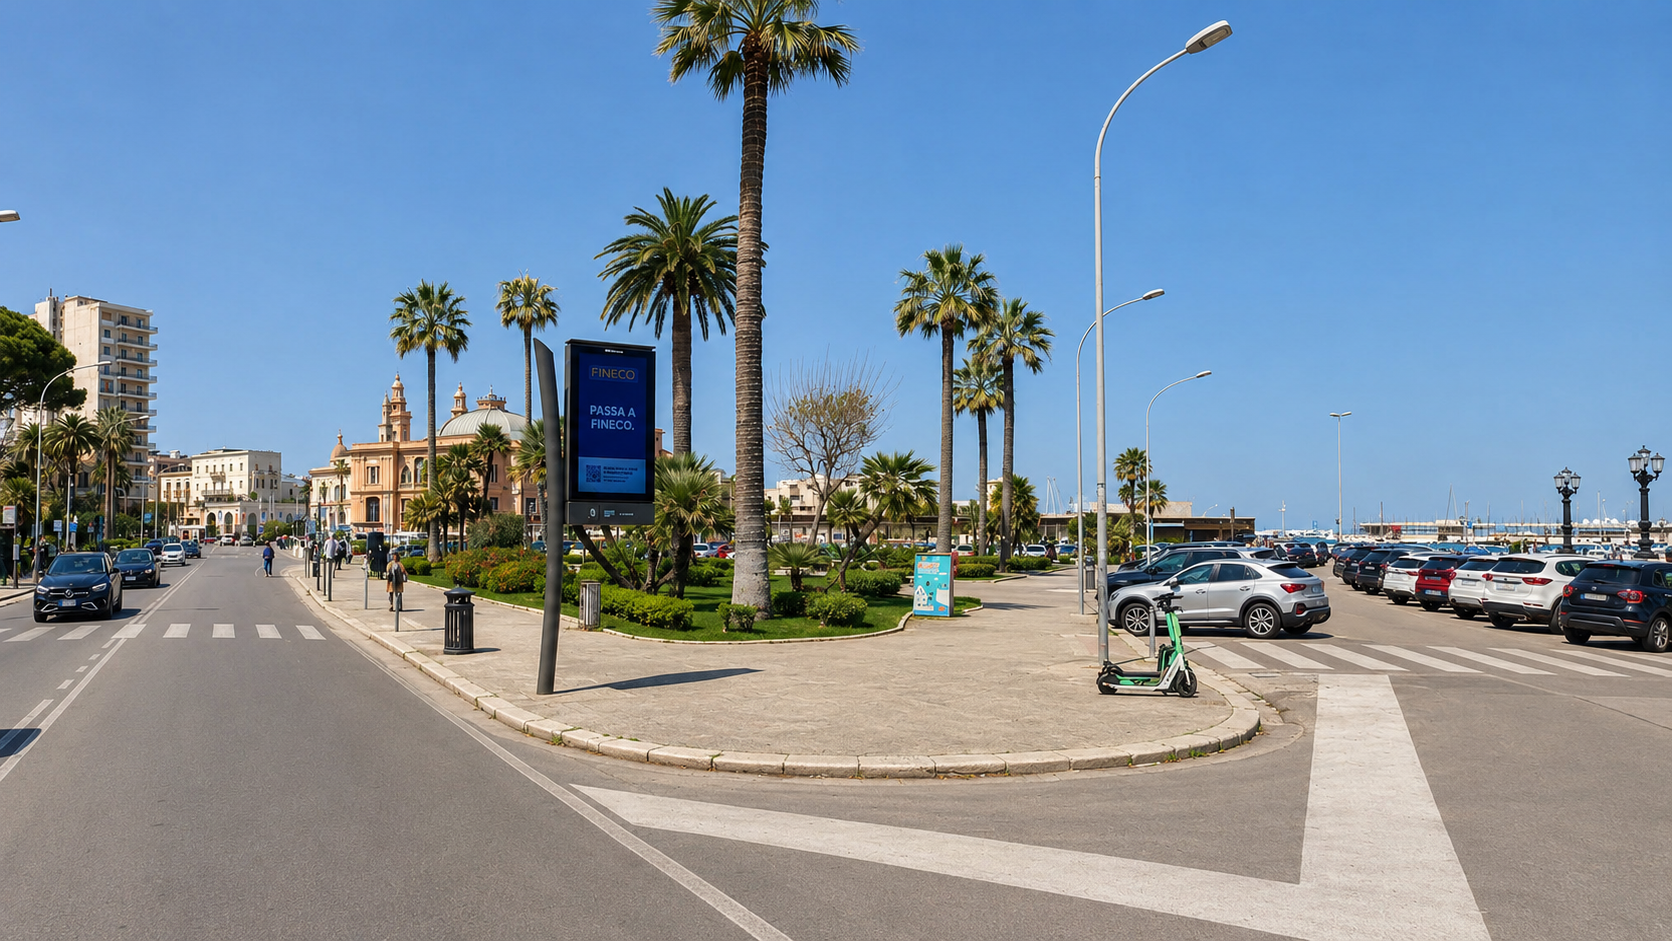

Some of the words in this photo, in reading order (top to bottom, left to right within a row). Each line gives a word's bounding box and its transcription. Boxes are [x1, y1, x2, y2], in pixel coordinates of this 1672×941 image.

[591, 367, 636, 380] FINECO
[590, 405, 625, 417] PASSA
[627, 407, 636, 418] A
[591, 418, 635, 431] FINECO.
